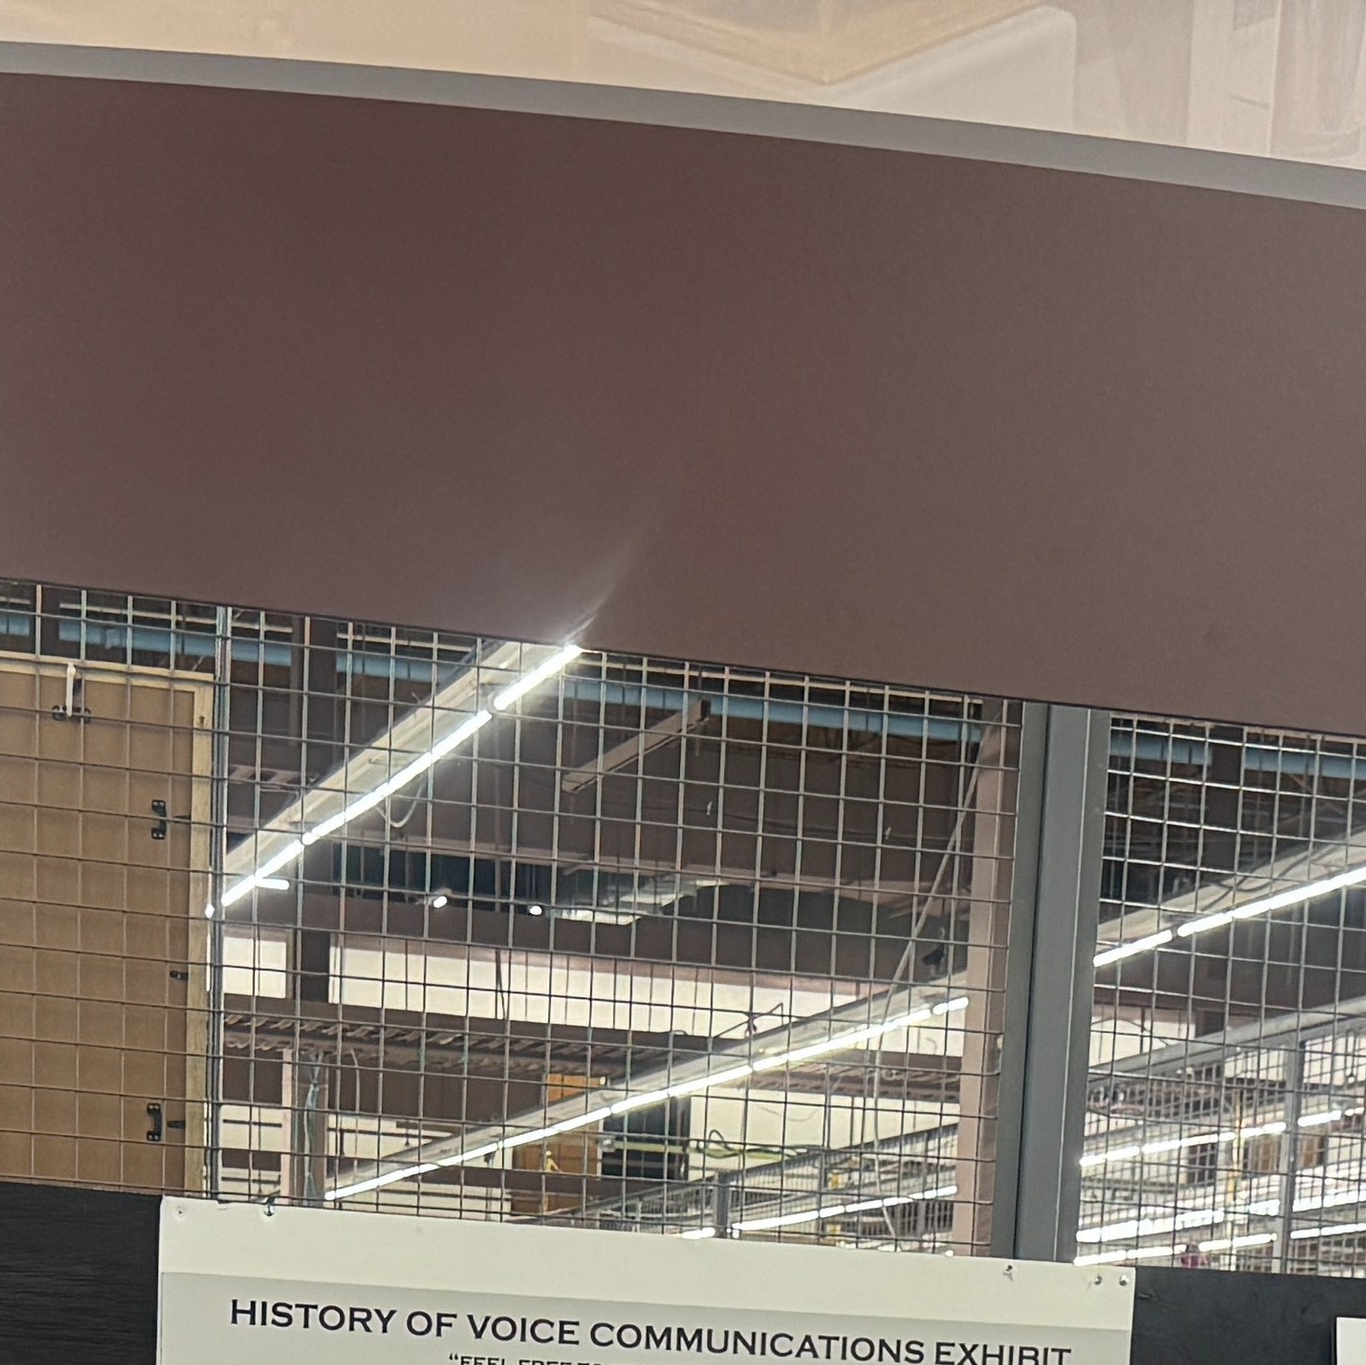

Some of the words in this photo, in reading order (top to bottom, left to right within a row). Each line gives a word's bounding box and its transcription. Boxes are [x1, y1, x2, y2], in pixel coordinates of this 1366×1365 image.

[231, 1299, 398, 1334] HISTORY
[406, 1310, 457, 1338] OF
[467, 1314, 580, 1345] VOICE
[590, 1321, 925, 1364] COMMUNICATIONS
